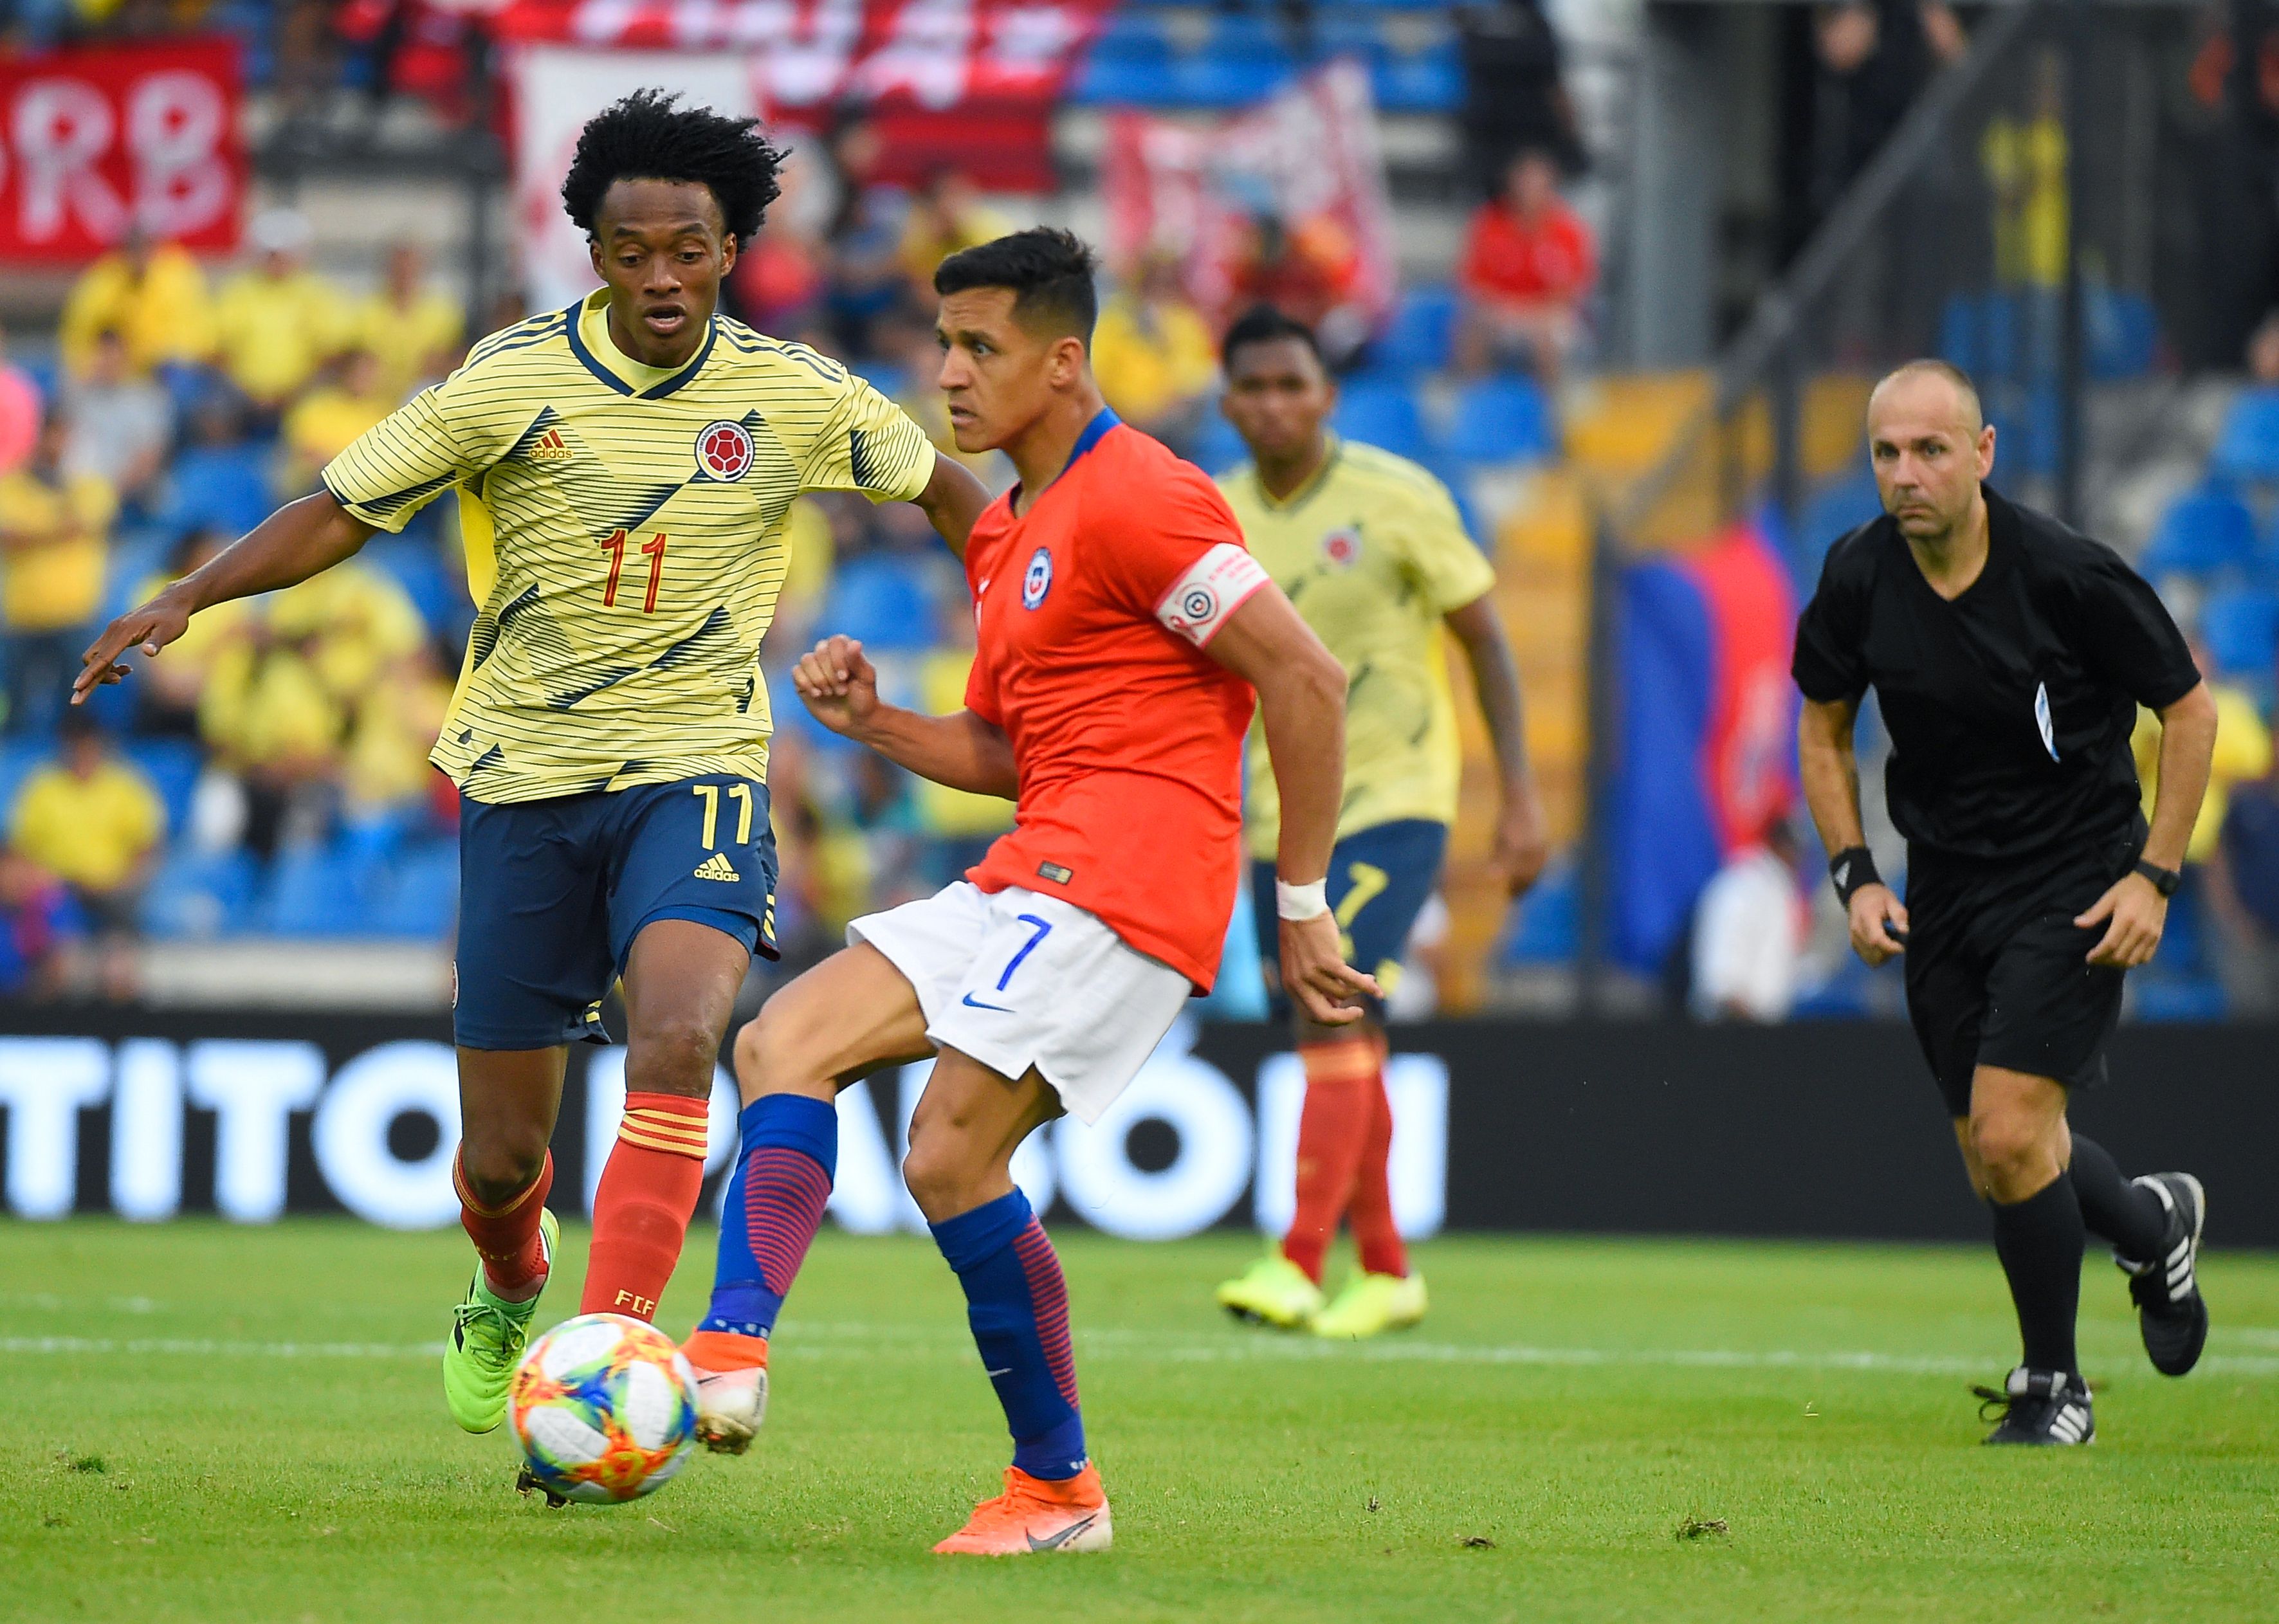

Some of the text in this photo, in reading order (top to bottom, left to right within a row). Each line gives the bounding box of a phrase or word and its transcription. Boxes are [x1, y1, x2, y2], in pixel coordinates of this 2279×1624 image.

[0, 74, 233, 246] RB
[529, 448, 572, 459] adidas
[600, 528, 667, 614] 11
[692, 783, 753, 850] 11
[693, 868, 740, 882] adidas
[1335, 861, 1389, 928] 7
[996, 913, 1052, 991] 7
[614, 1289, 655, 1315] FCF
